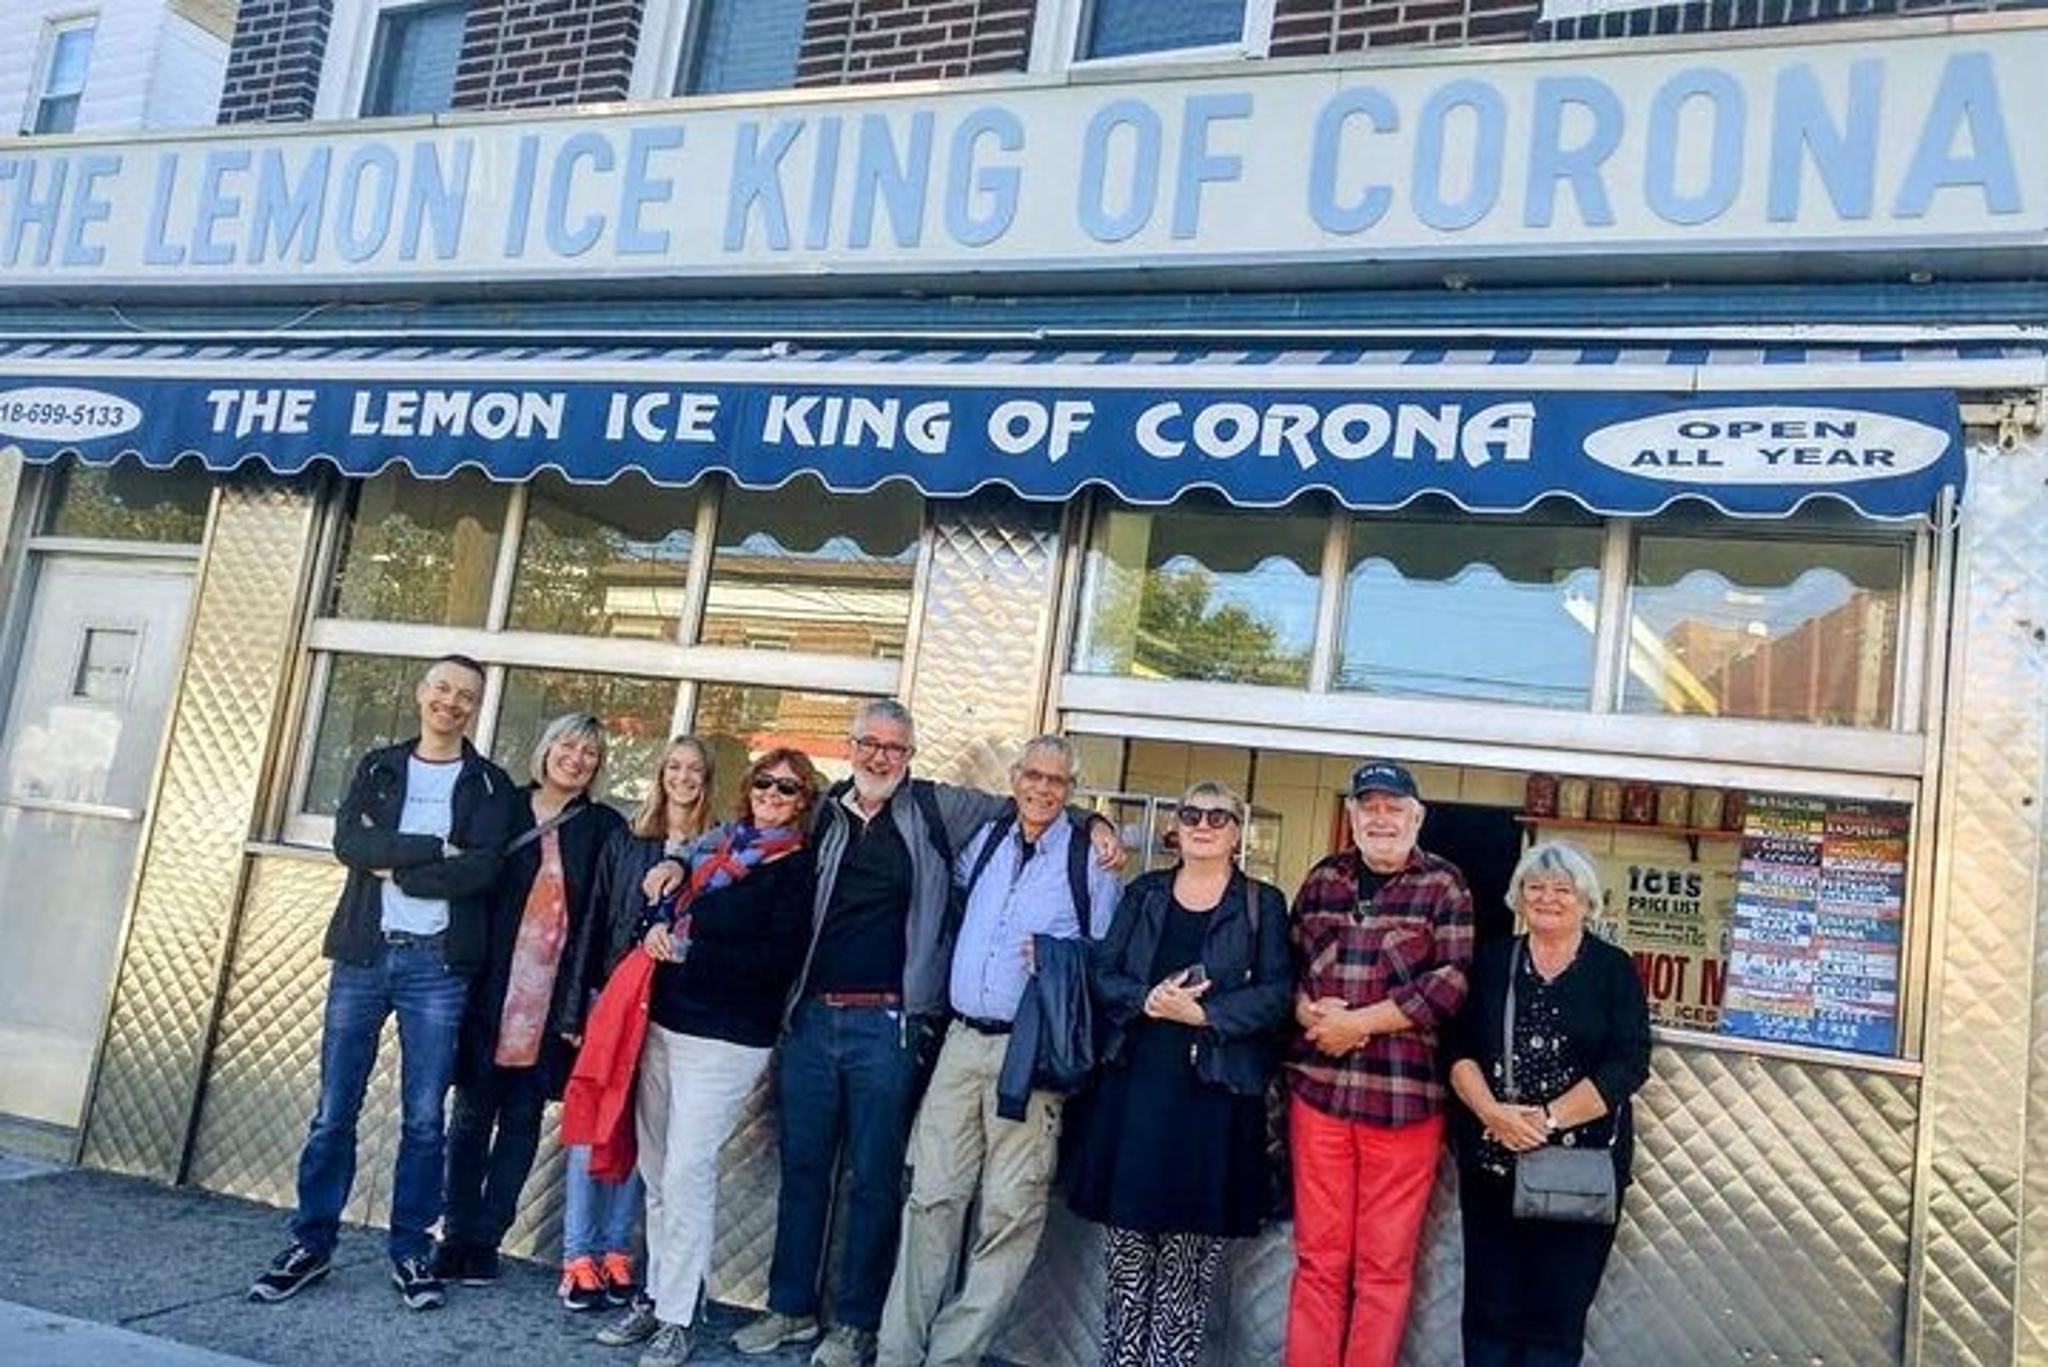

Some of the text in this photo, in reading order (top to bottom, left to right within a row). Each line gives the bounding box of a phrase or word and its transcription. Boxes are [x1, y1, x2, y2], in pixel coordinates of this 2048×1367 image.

[143, 139, 473, 265] LEMON
[503, 126, 684, 258] ICE
[723, 107, 1025, 252] KING
[1077, 92, 1253, 243] OF
[1308, 50, 2024, 235] CORONA
[206, 389, 1537, 470] THE LEMON ICE KING OF CORONA
[1677, 419, 1857, 440] OPEN
[1631, 447, 1896, 468] ALL YEAR
[1629, 866, 1703, 898] ICES
[1628, 896, 1701, 914] PRICE LIST
